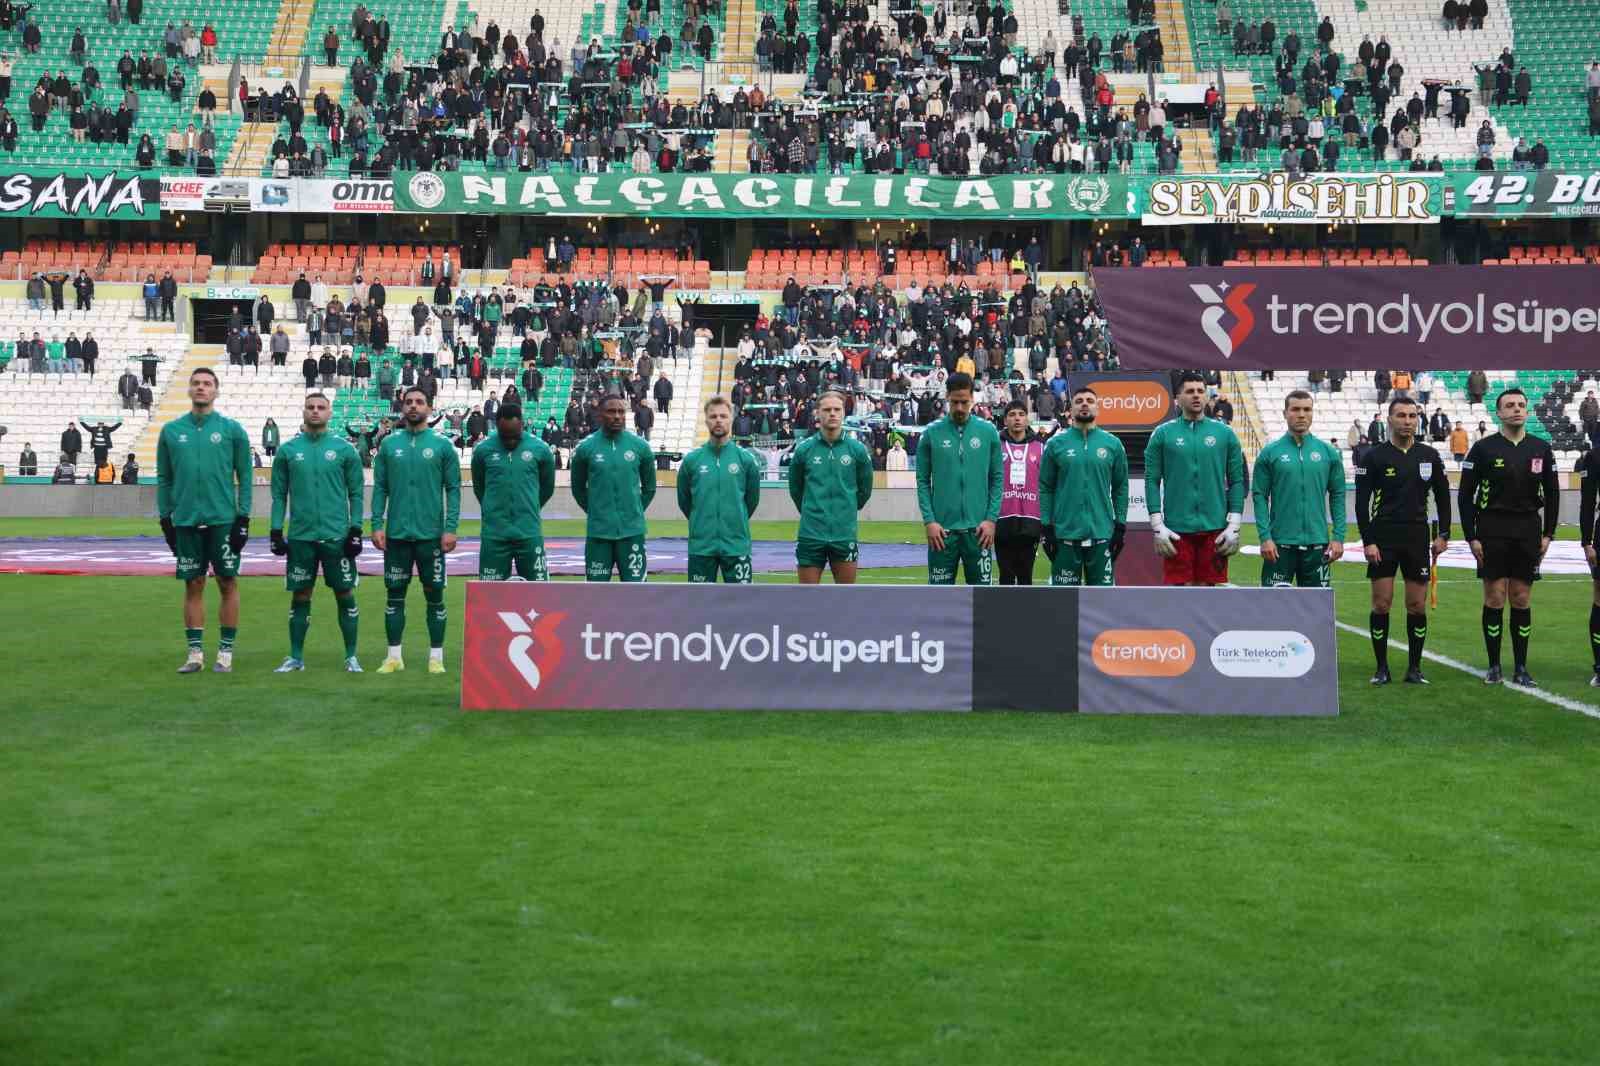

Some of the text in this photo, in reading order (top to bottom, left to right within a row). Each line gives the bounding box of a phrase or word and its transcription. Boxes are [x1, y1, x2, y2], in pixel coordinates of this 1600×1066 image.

[0, 171, 146, 217] SANA
[1463, 175, 1535, 204] 42.
[1267, 293, 1485, 343] trendyol
[1096, 393, 1161, 413] rendyol
[341, 557, 350, 573] 9
[434, 558, 443, 573] 5
[628, 553, 644, 569] 23
[977, 557, 992, 573] 16
[1104, 558, 1113, 574] 4
[735, 563, 751, 580] 32
[580, 623, 945, 674] trendyol SüperLig
[1102, 642, 1186, 663] trendyol
[1215, 647, 1289, 658] Türk Telekom
